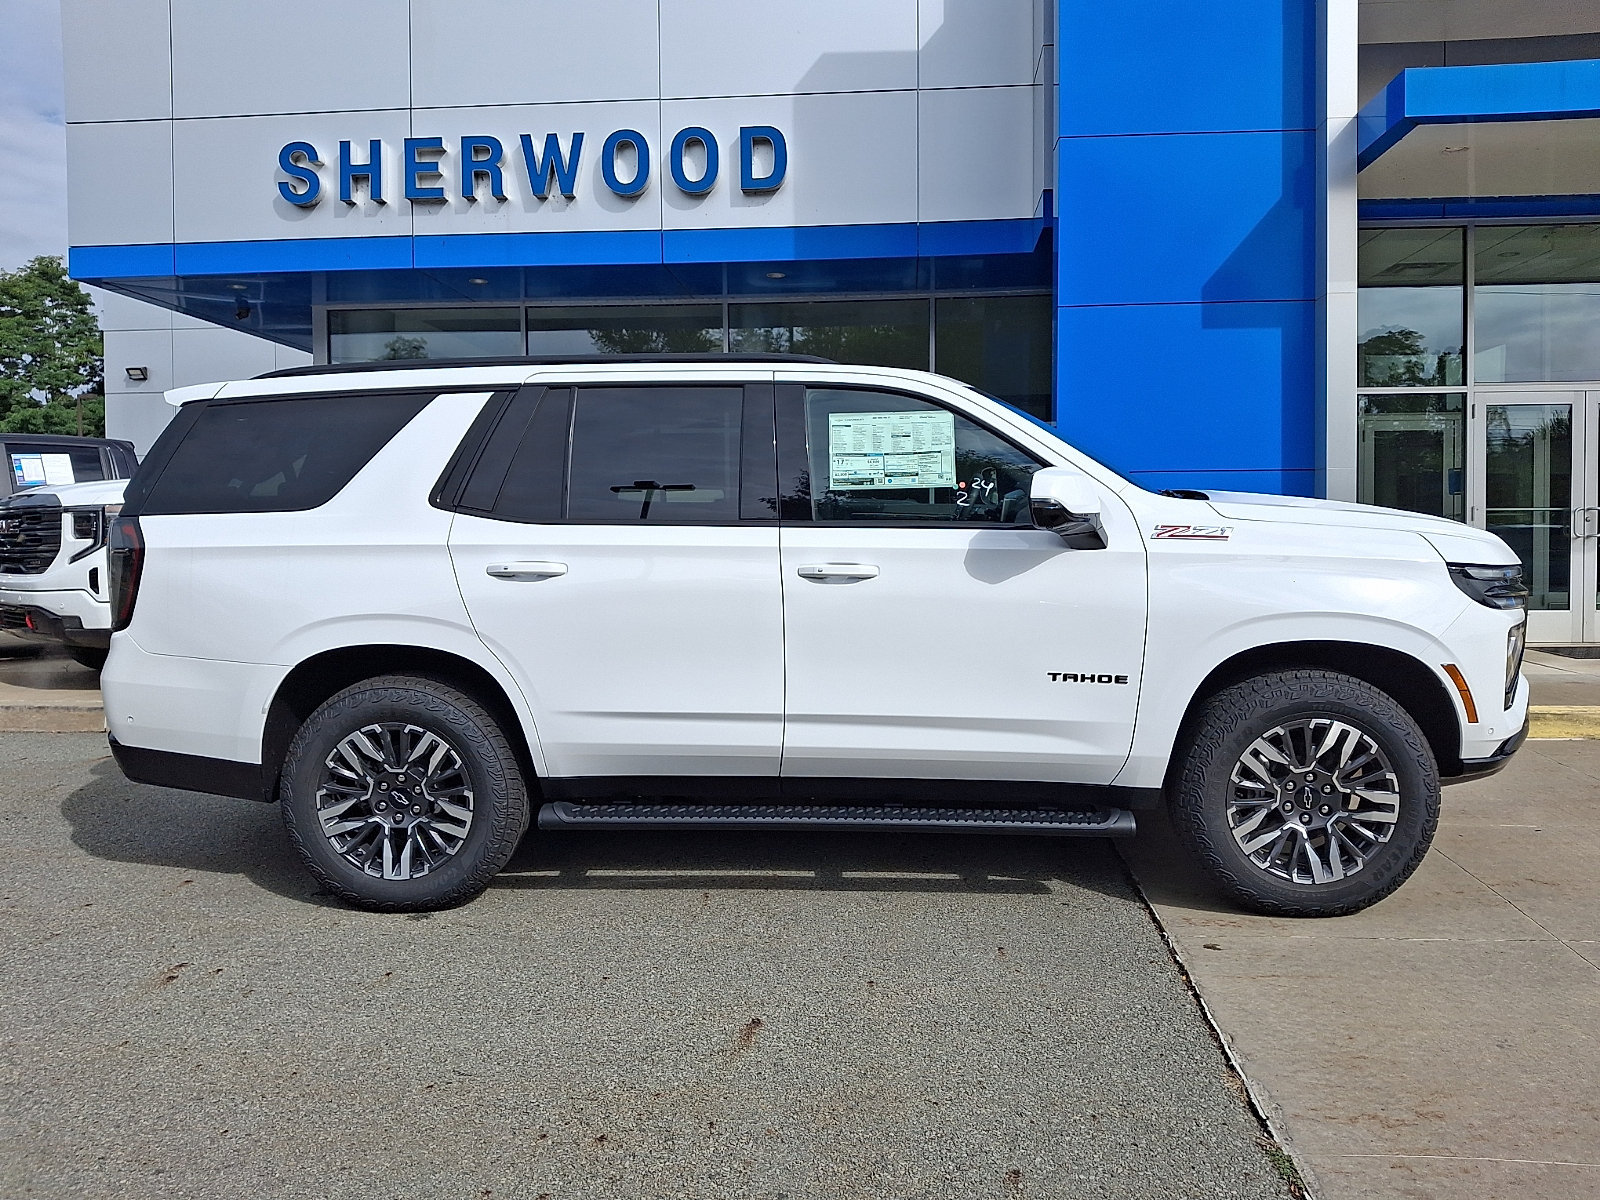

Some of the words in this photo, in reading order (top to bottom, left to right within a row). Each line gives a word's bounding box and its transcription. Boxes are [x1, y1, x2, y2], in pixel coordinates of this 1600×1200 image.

[277, 125, 789, 206] SHERWOOD
[956, 491, 971, 507] 2
[1150, 524, 1235, 541] Z71
[1046, 672, 1129, 685] TAHOE
